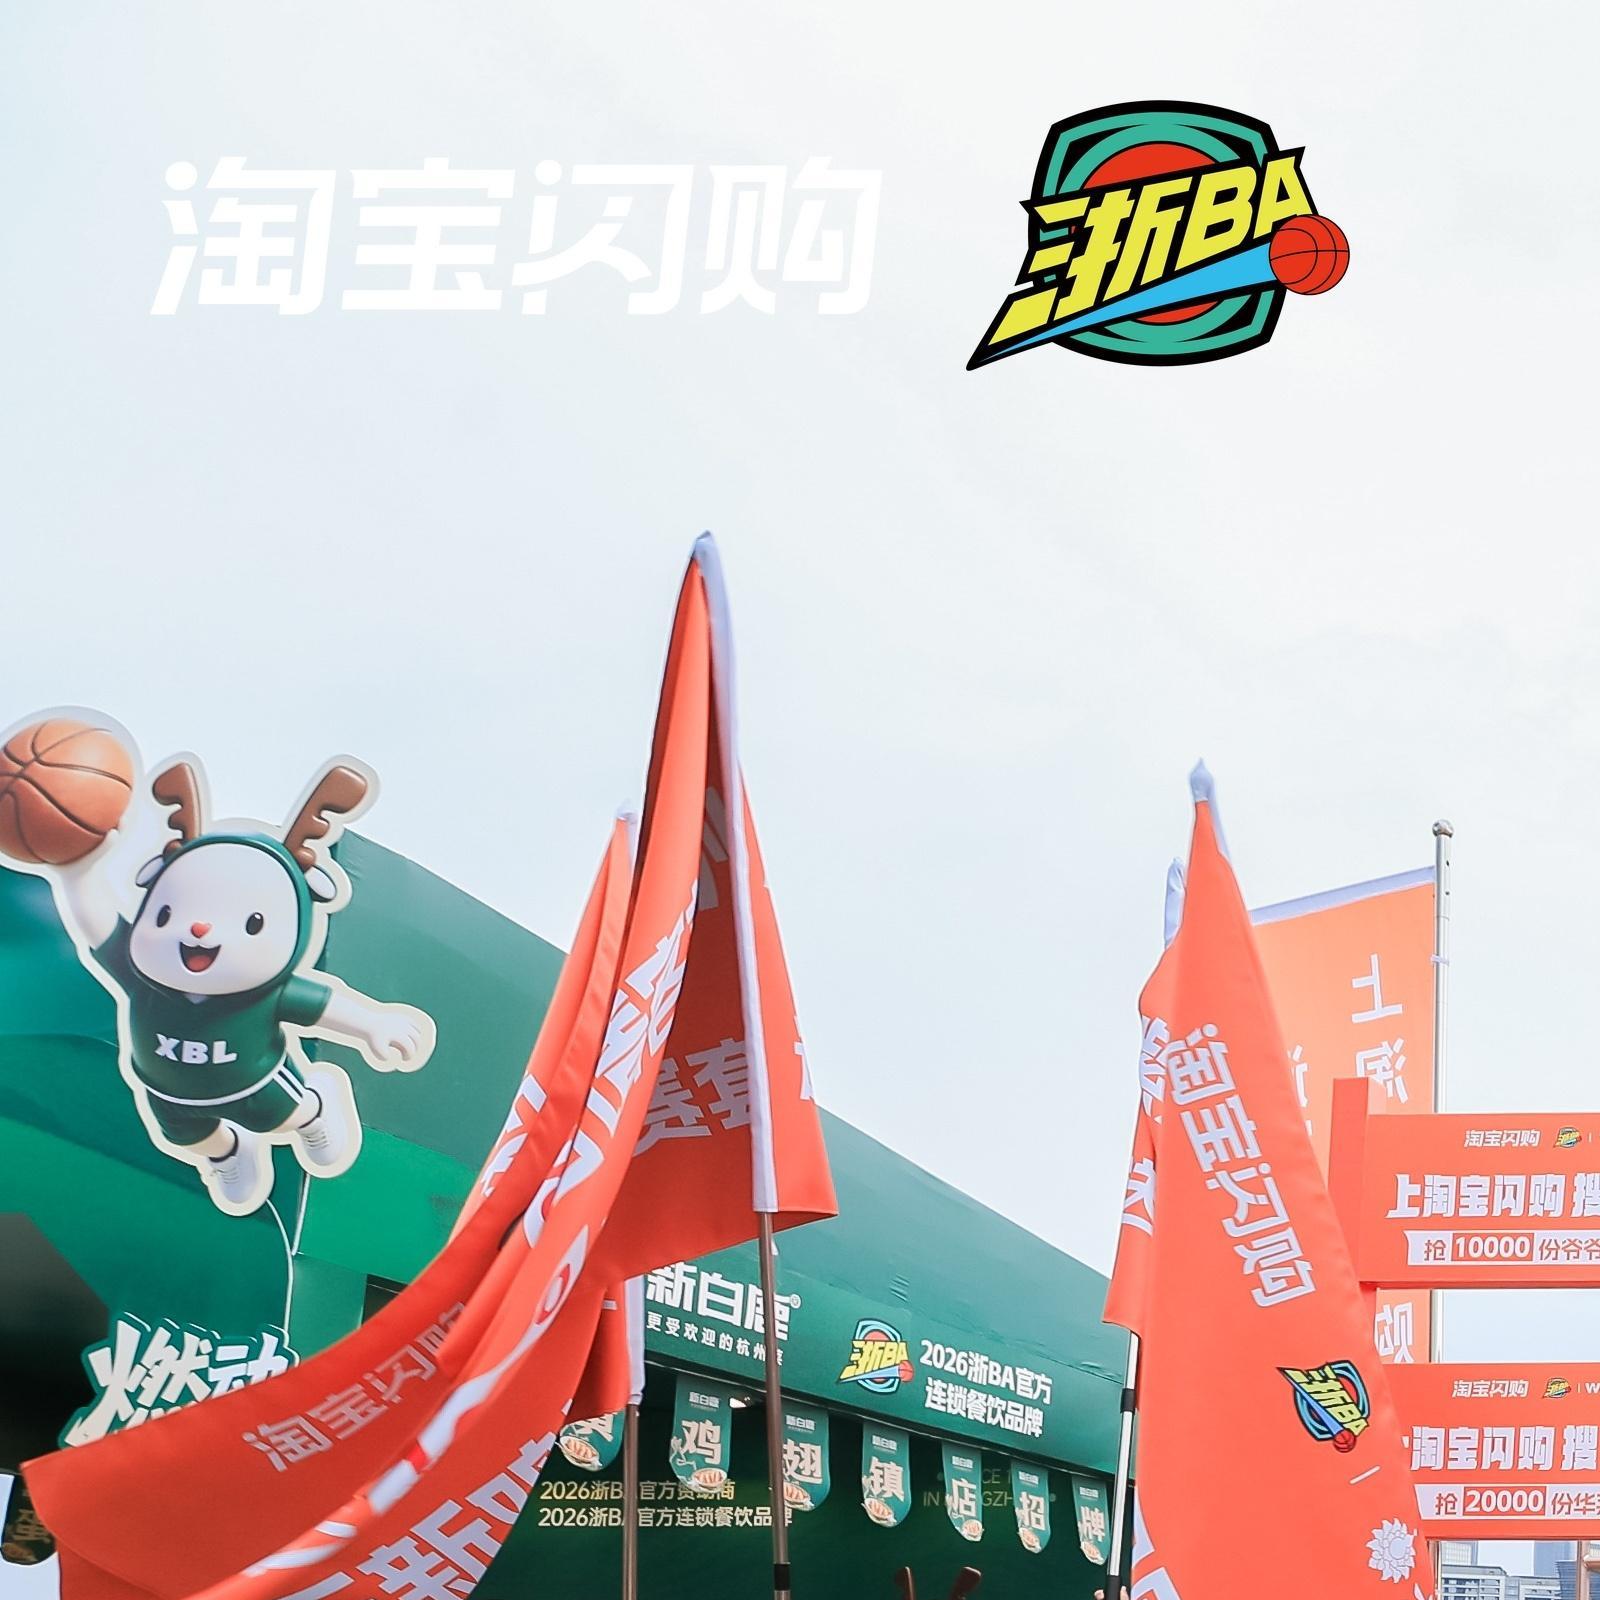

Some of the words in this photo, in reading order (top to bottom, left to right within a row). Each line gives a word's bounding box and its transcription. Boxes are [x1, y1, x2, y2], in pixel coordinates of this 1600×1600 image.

[154, 1033, 238, 1065] XBL
[1464, 1129, 1540, 1148] 淘宝闪购
[1166, 1022, 1317, 1308] 淘宝闪购
[1385, 1173, 1567, 1219] 上淘宝闪购
[645, 1261, 791, 1341] 新白鹿
[919, 1339, 1053, 1405] 2026浙BA官方
[1452, 1379, 1529, 1398] 淘宝闪购
[922, 1376, 1045, 1438] 连锁餐饮品牌
[682, 1418, 722, 1466] 鸡
[783, 1437, 823, 1485] 翅
[1402, 1424, 1556, 1472] 淘宝闪购
[867, 1455, 905, 1504] 镇
[951, 1477, 978, 1518] 店
[1018, 1491, 1045, 1531] 招
[1077, 1505, 1106, 1544] 牌
